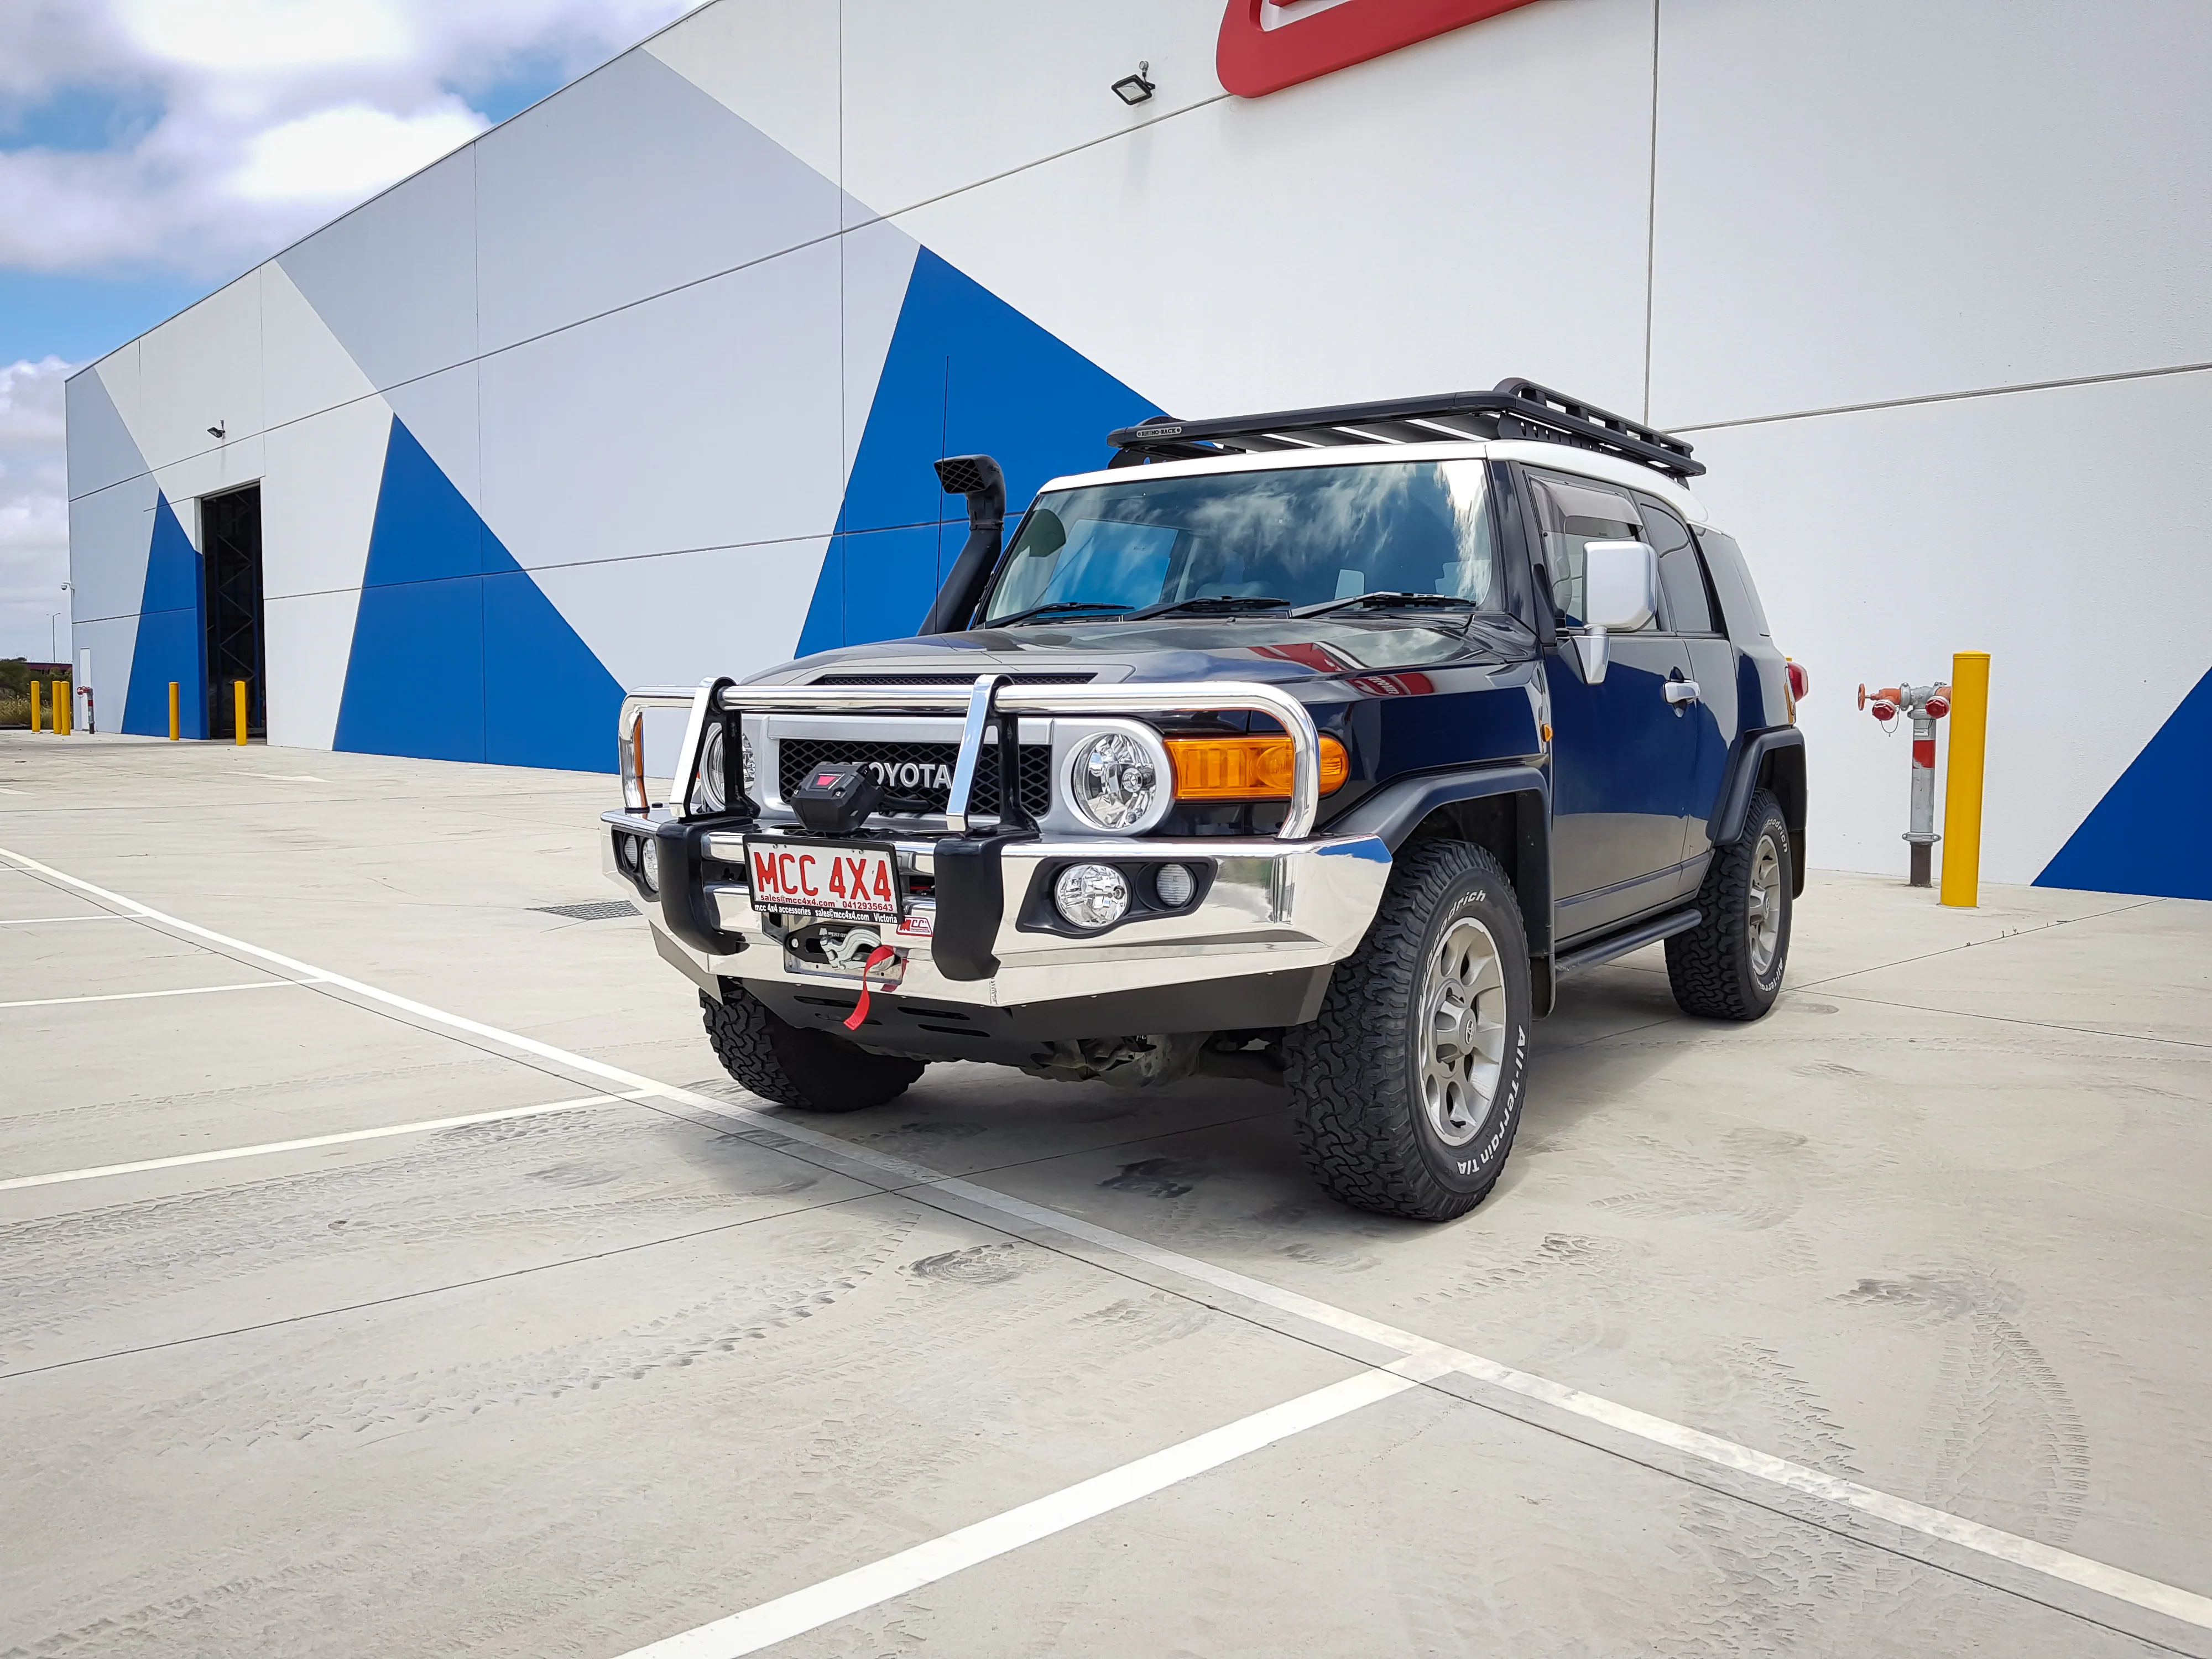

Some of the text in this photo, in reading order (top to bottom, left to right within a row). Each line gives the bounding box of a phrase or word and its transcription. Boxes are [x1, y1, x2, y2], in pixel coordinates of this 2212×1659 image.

[1141, 428, 1176, 436] RHINO-RACK
[754, 852, 891, 901] MCC 4X4
[760, 894, 894, 912] sales@mcc4x4.com 0412935643
[767, 903, 778, 912] 4x4
[779, 906, 811, 916] accessories
[815, 908, 870, 921] sales@mcc4x4.com
[873, 912, 898, 924] Victoria
[1457, 1025, 1525, 1175] All-Terrain T/A
